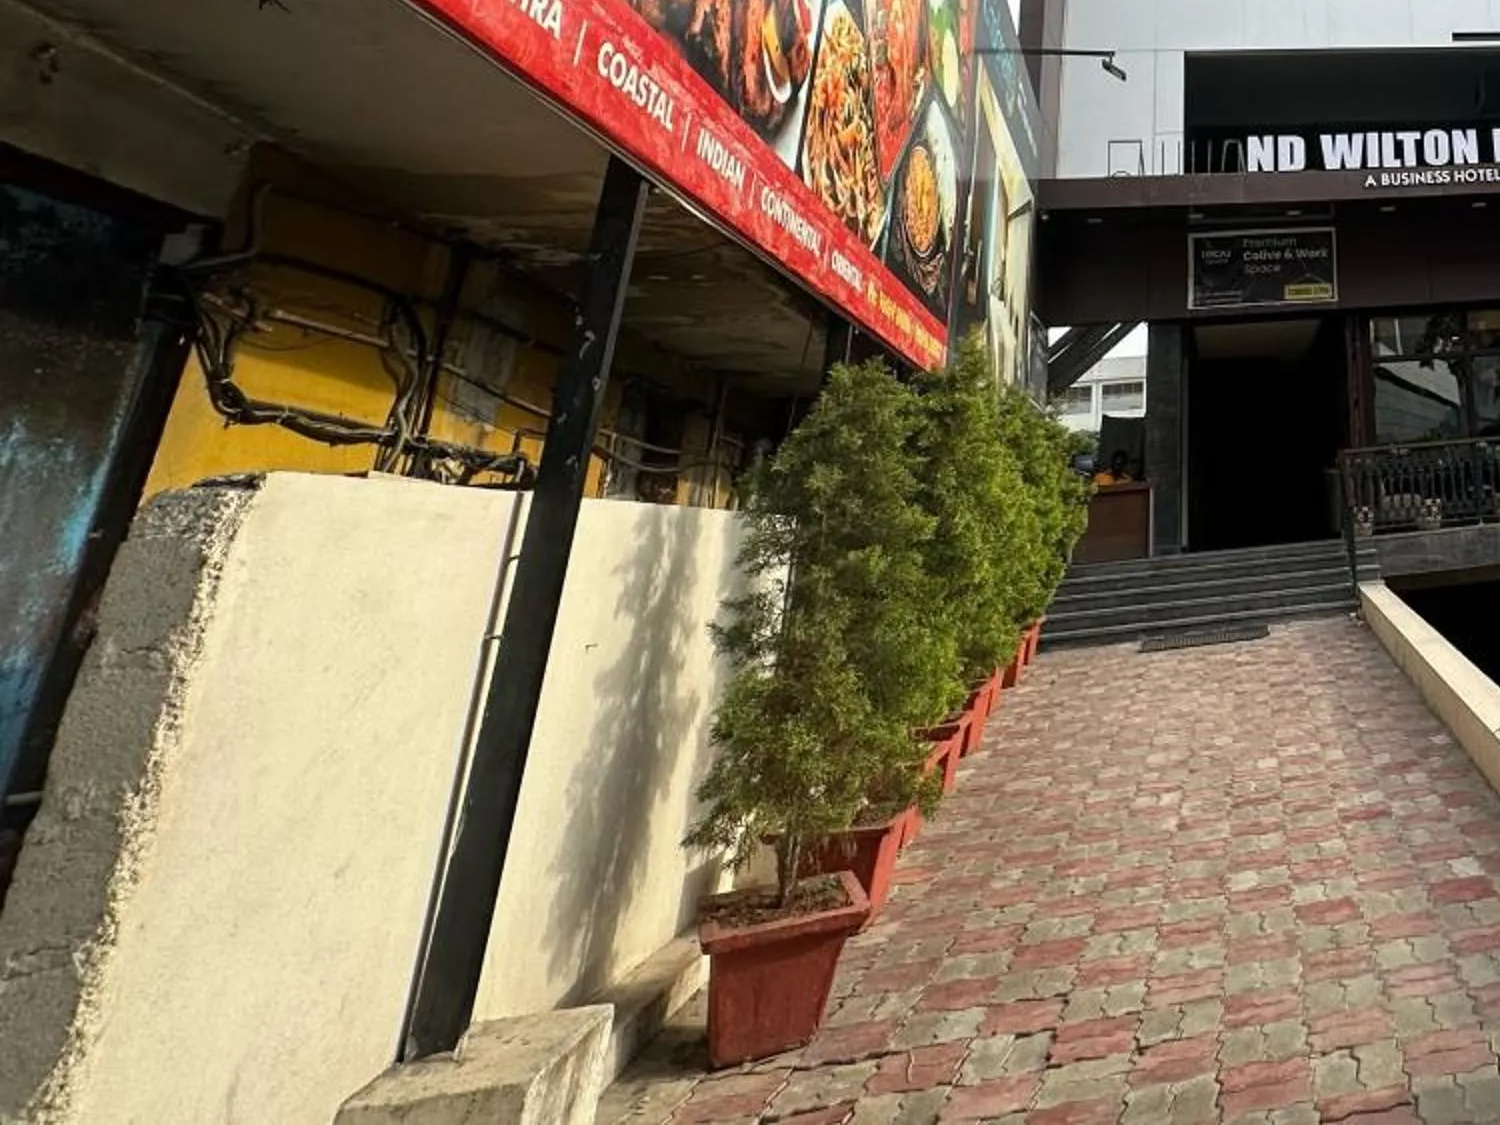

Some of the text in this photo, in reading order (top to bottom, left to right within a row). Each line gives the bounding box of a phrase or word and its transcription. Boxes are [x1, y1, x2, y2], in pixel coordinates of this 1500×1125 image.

[596, 40, 674, 132] COASTAL
[697, 127, 746, 193] INDIAN
[1319, 128, 1479, 171] WILTON
[1365, 174, 1377, 187] A
[1380, 170, 1451, 186] BUSINESS
